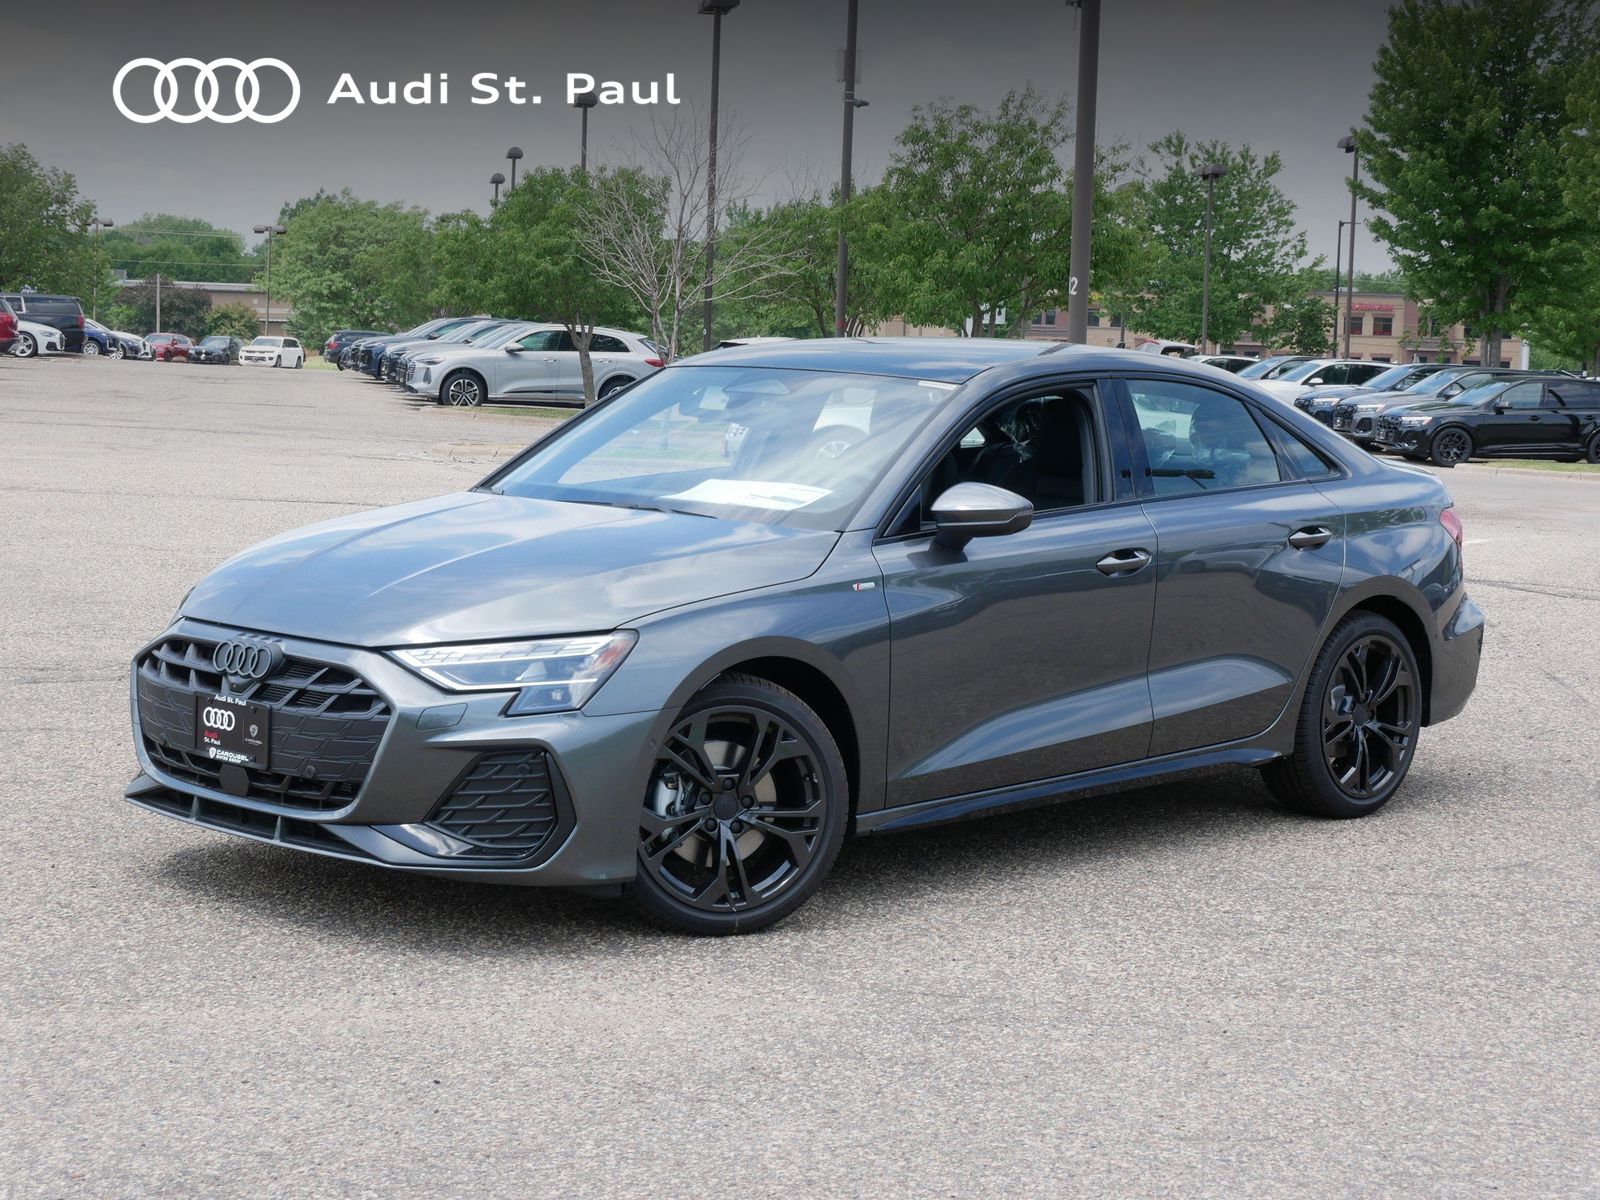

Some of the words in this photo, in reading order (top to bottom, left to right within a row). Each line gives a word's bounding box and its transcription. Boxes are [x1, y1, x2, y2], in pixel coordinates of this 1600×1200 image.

[214, 694, 226, 702] Audi
[235, 698, 246, 706] Paul
[203, 730, 218, 739] Audi
[216, 749, 249, 761] CAROUSEL
